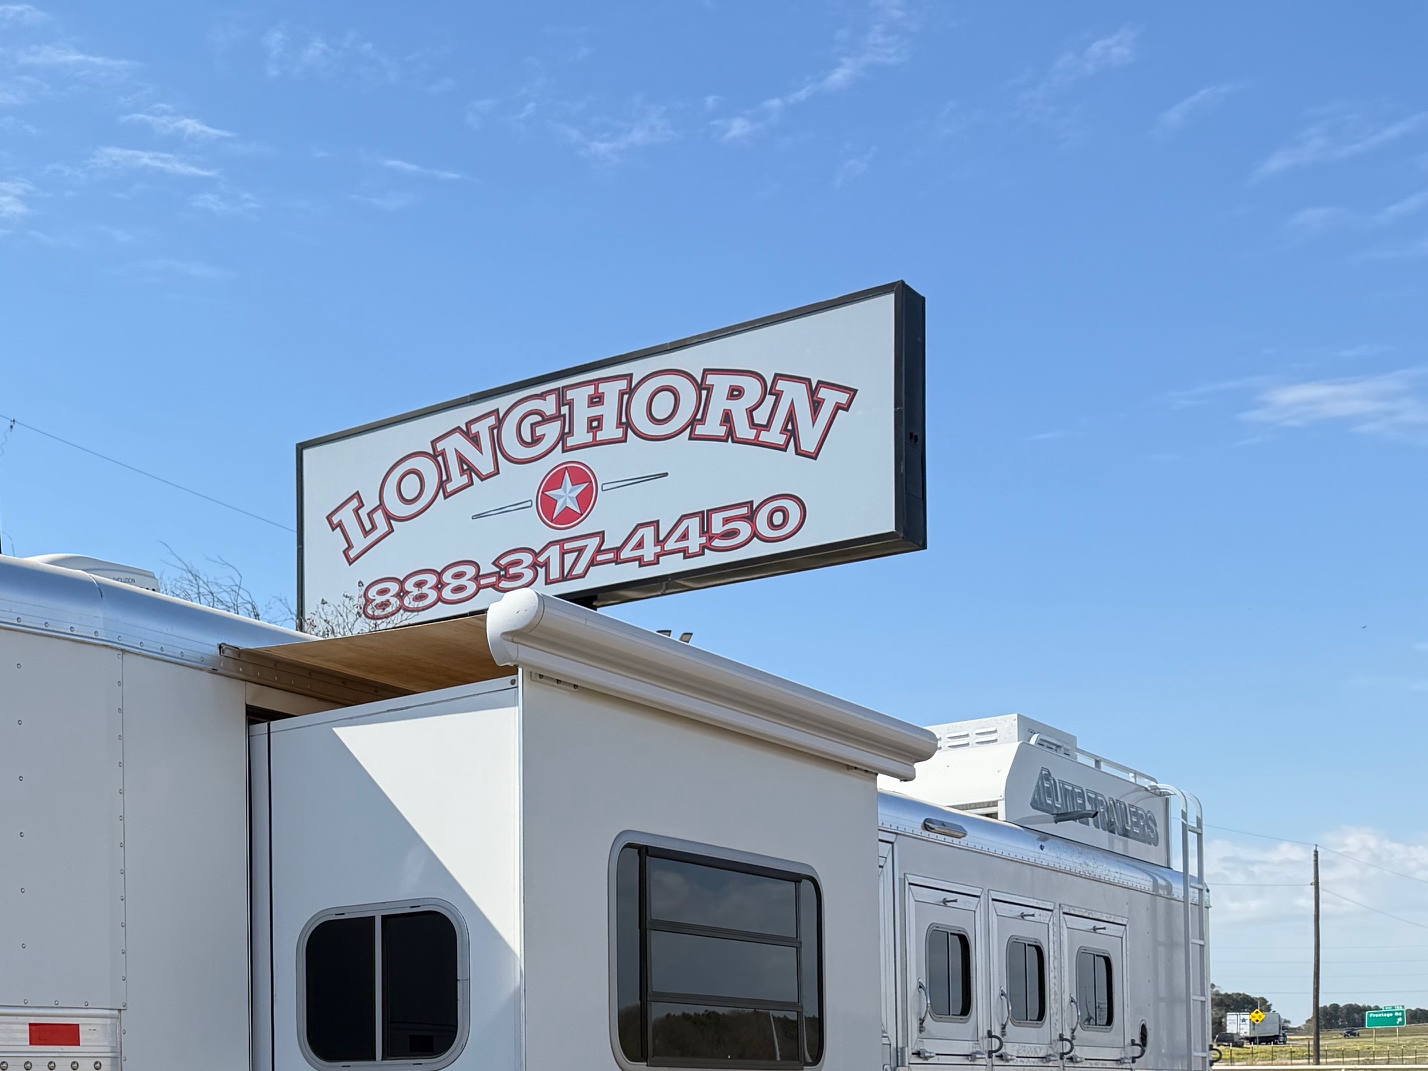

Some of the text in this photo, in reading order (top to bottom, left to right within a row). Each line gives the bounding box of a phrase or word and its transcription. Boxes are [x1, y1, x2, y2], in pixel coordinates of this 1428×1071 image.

[326, 367, 858, 566] LONGHORN
[363, 493, 807, 620] 888-317-4450
[1086, 788, 1160, 847] TRAILERS
